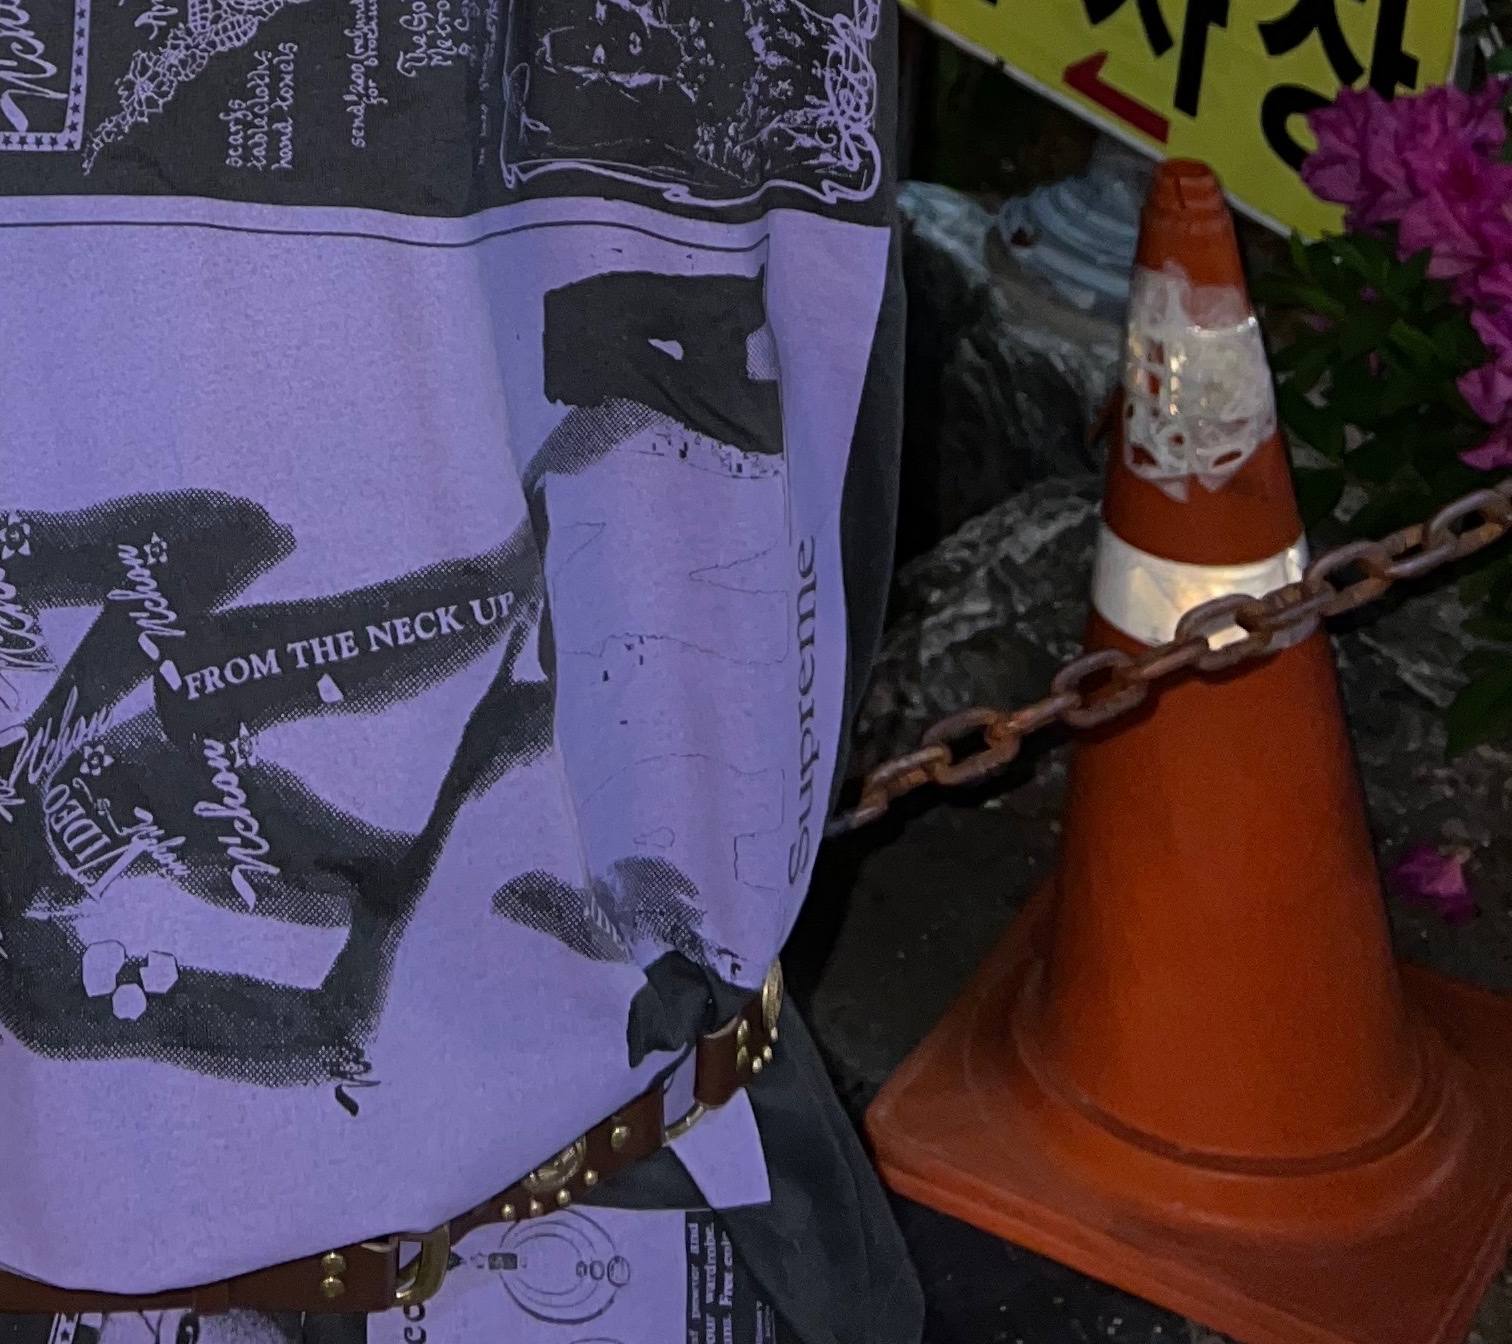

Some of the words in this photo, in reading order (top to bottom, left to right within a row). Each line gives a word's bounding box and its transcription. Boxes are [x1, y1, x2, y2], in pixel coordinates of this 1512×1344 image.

[345, 100, 366, 149] send
[362, 78, 389, 105] for
[219, 98, 253, 168] scarfs
[184, 648, 282, 701] FROM
[287, 630, 360, 670] THE
[365, 604, 465, 653] NECK
[469, 590, 515, 626] UP
[788, 534, 818, 888] Supreme
